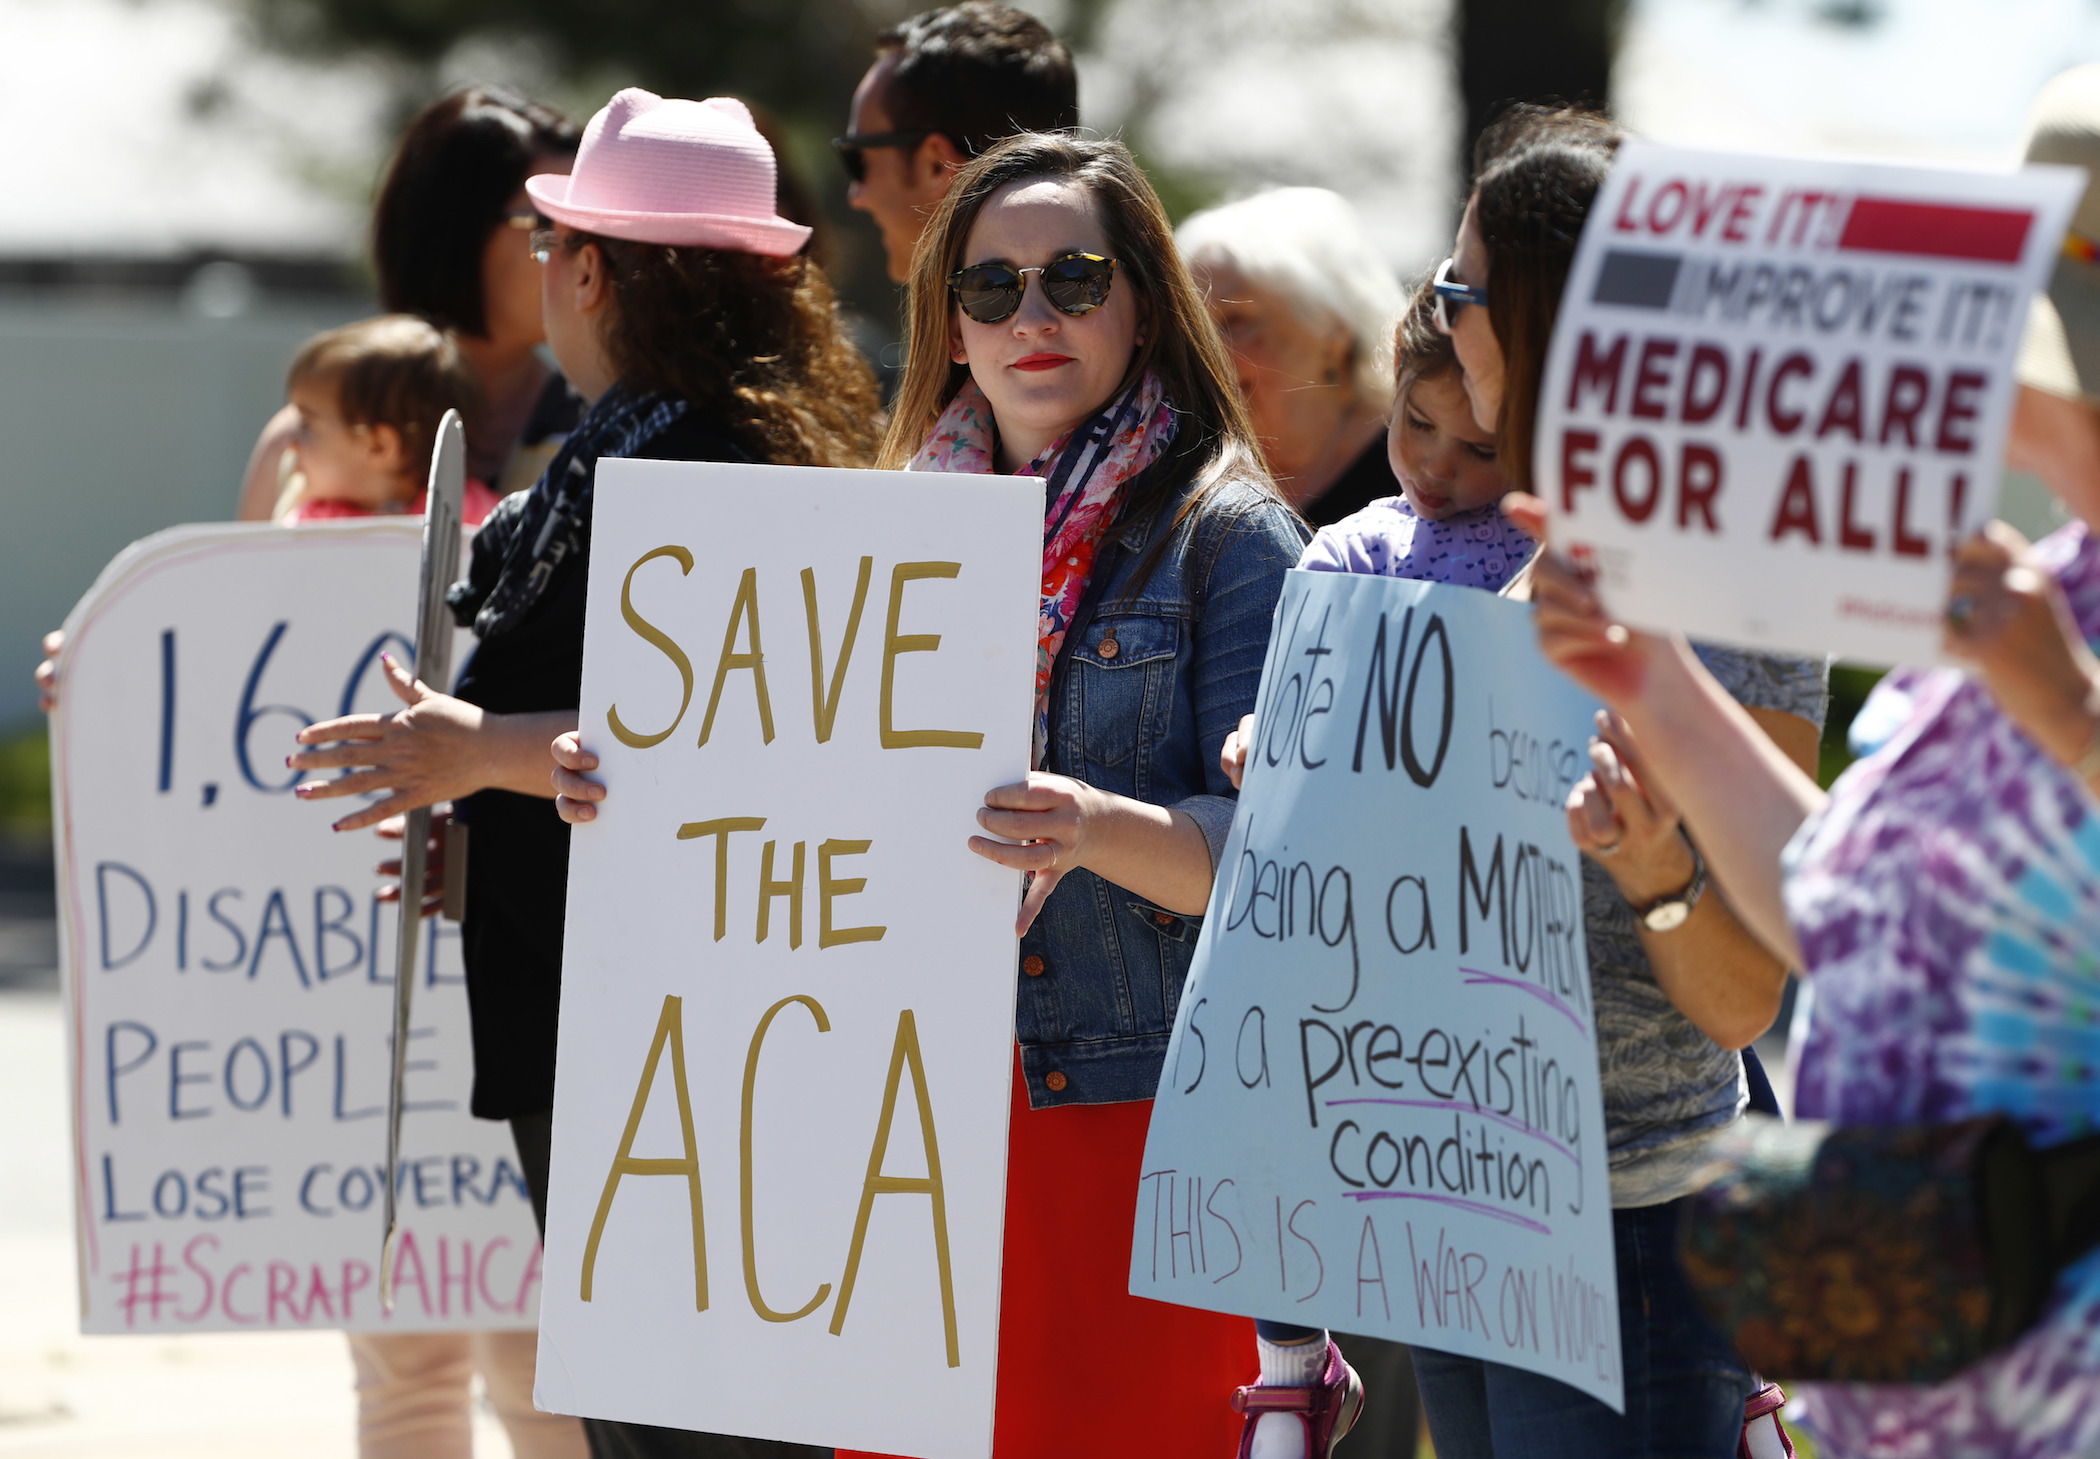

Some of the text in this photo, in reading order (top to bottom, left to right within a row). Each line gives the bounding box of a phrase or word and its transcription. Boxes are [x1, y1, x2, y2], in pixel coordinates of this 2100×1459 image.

[1614, 174, 1846, 250] LOVE IT!
[1670, 252, 2018, 350] IMPROVE IT!
[1566, 328, 1990, 457] MEDICARE
[1560, 426, 1972, 562] FOR ALL!
[606, 544, 984, 751] SAVE
[1251, 588, 1334, 770] Vote
[1352, 606, 1454, 789] NO
[677, 816, 888, 951] THE
[1226, 812, 1590, 1018] being a MOTHER
[105, 1020, 458, 1128] PEOPLE
[1172, 980, 1584, 1216] is a pre-existing
[102, 1152, 274, 1224] LOSE
[580, 993, 960, 1370] ACA
[1330, 1112, 1550, 1215] condition
[1141, 1168, 1242, 1285] THIS
[1276, 1195, 1324, 1303] IS
[1356, 1214, 1390, 1322] A
[1406, 1220, 1491, 1342] WAR
[1499, 1265, 1540, 1356] ON
